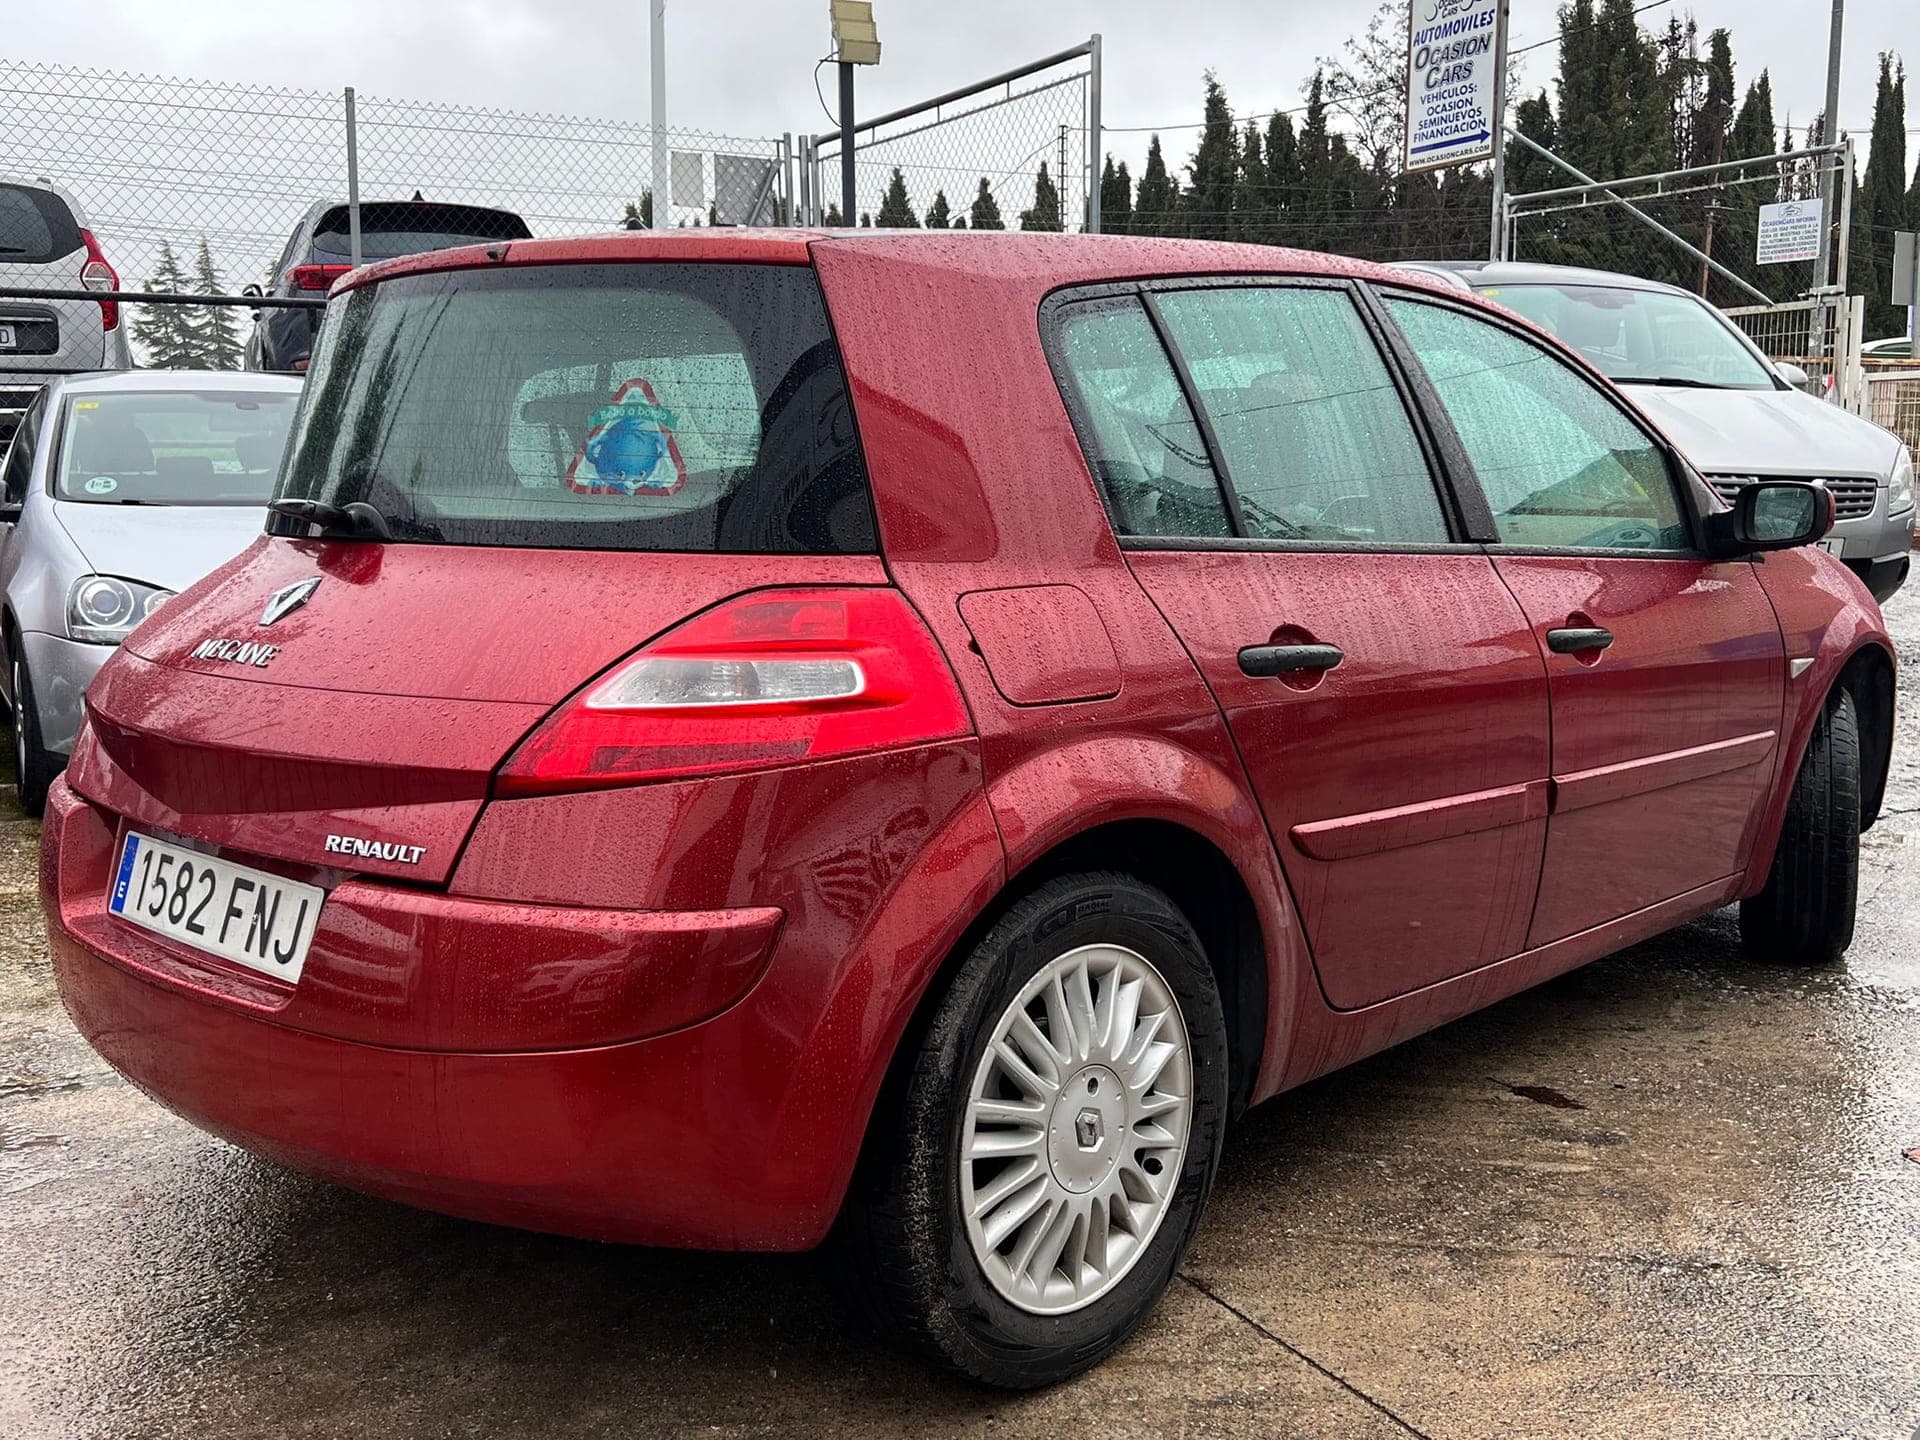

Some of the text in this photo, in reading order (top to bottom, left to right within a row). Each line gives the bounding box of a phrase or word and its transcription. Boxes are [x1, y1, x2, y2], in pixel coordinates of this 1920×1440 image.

[1413, 9, 1495, 47] AUTOMOVILES
[1415, 32, 1494, 71] OCASION
[1426, 60, 1474, 91] CARS
[1418, 107, 1482, 130] SEMINUEVOS
[1427, 97, 1473, 117] OCASION
[1413, 118, 1487, 143] FINANCIACION
[1409, 144, 1490, 167] WWW.OCASIONCARS.COM
[191, 638, 281, 668] MEGANE
[324, 834, 428, 865] RENAULT
[116, 879, 127, 901] E
[136, 849, 309, 965] 1582 FNJ
